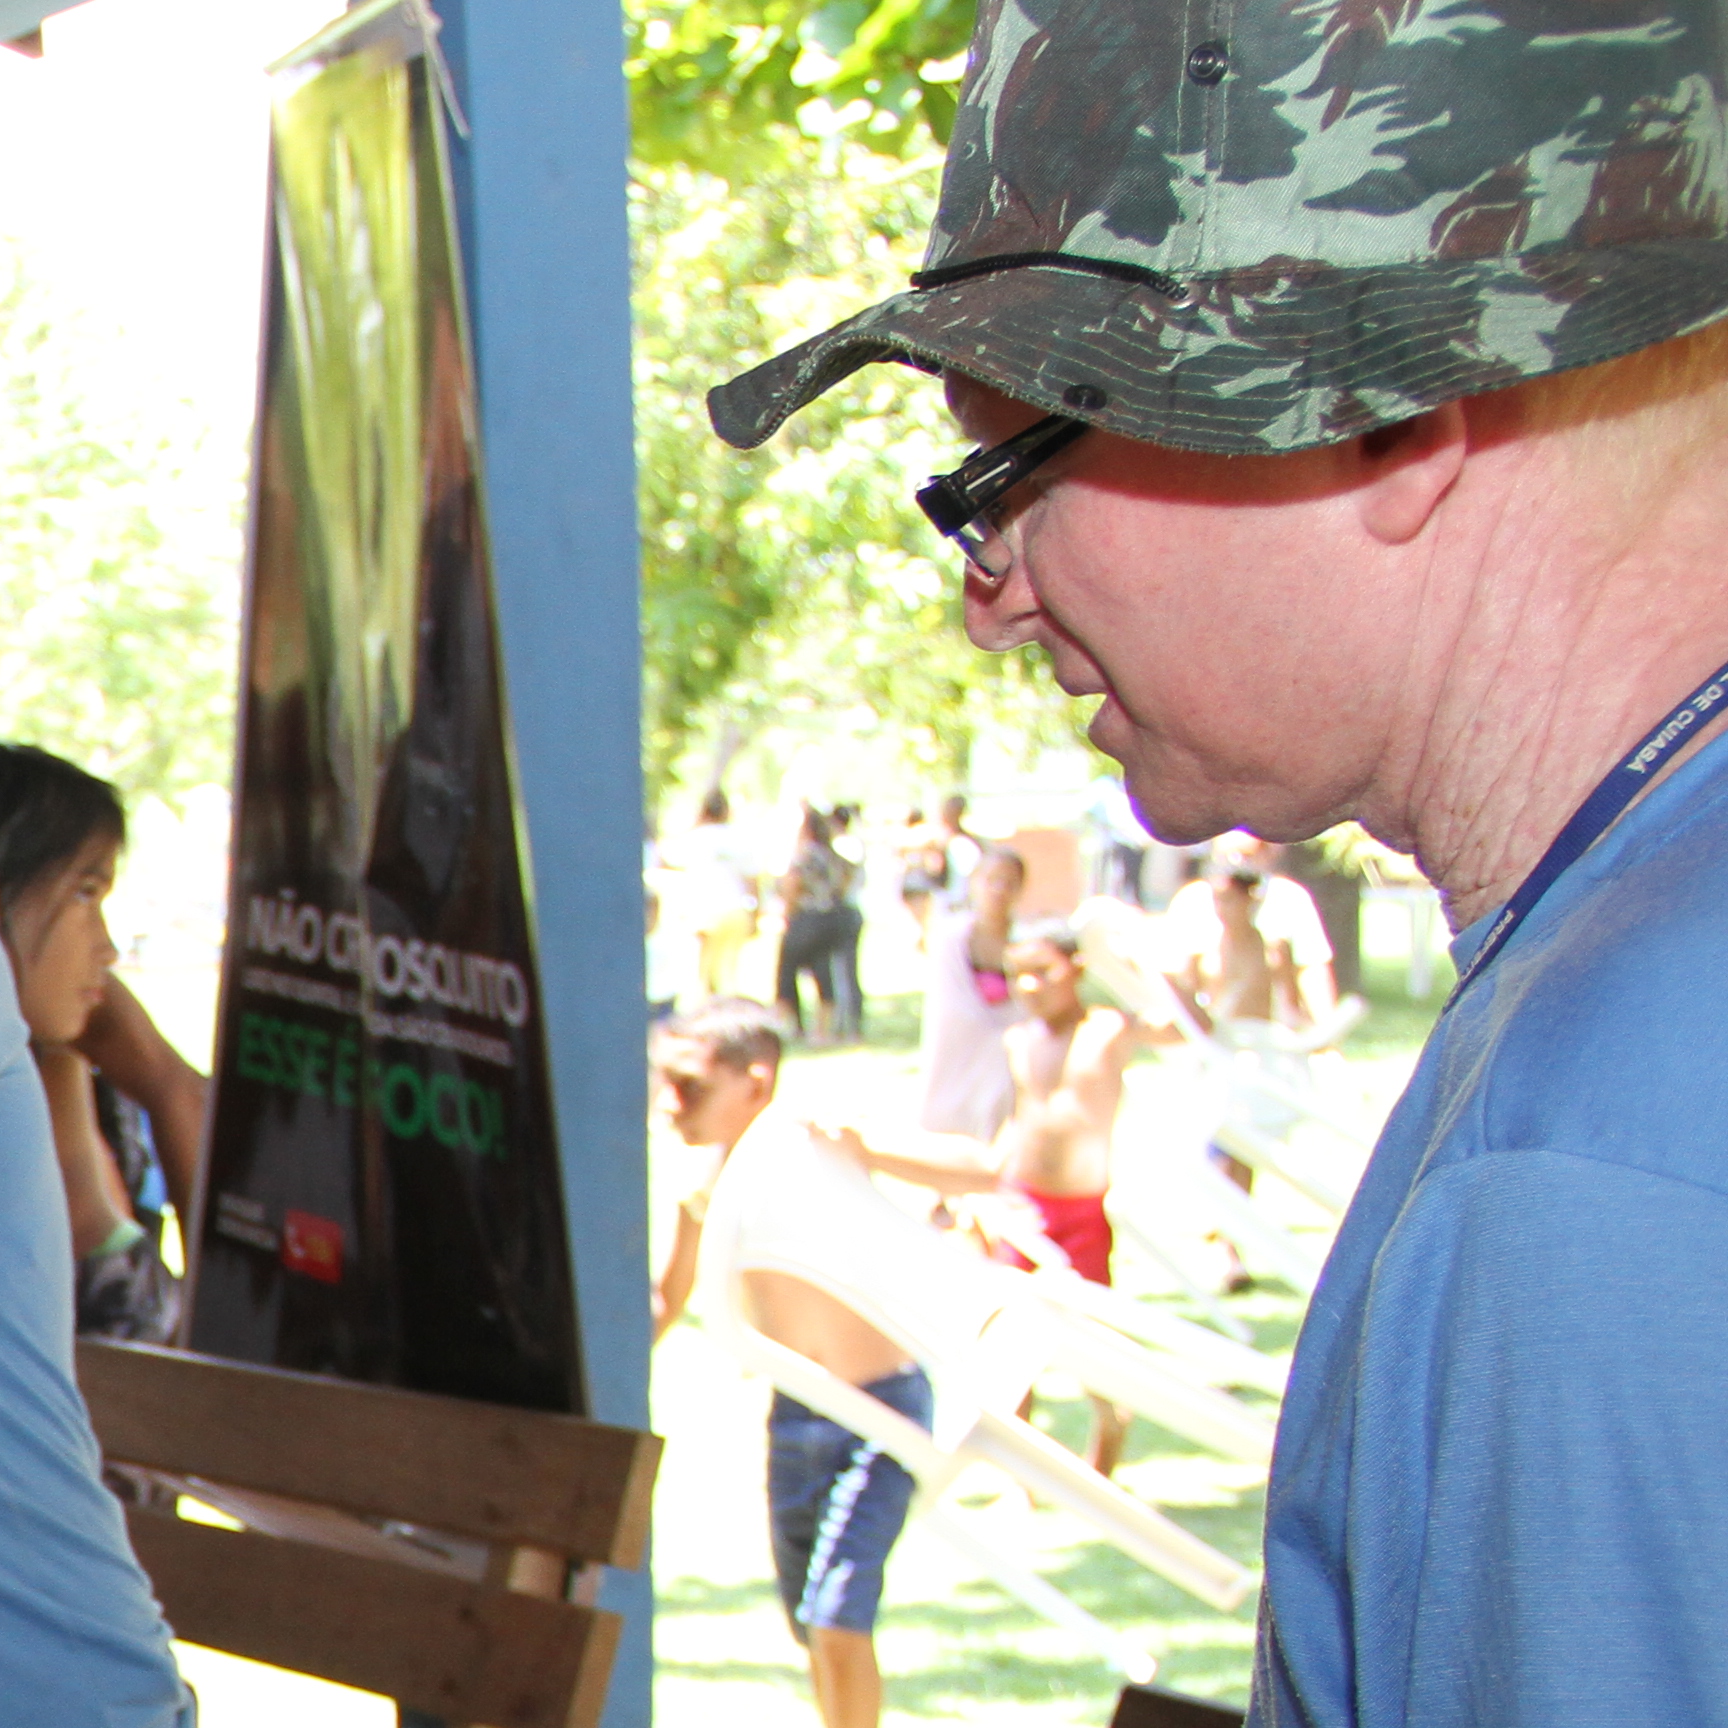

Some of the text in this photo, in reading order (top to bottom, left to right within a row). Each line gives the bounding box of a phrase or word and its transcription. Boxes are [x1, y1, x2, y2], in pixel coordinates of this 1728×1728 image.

[1627, 684, 1723, 774] DE CUIABÁ
[247, 889, 322, 964] NÃO
[375, 935, 530, 1028] OSQUITO
